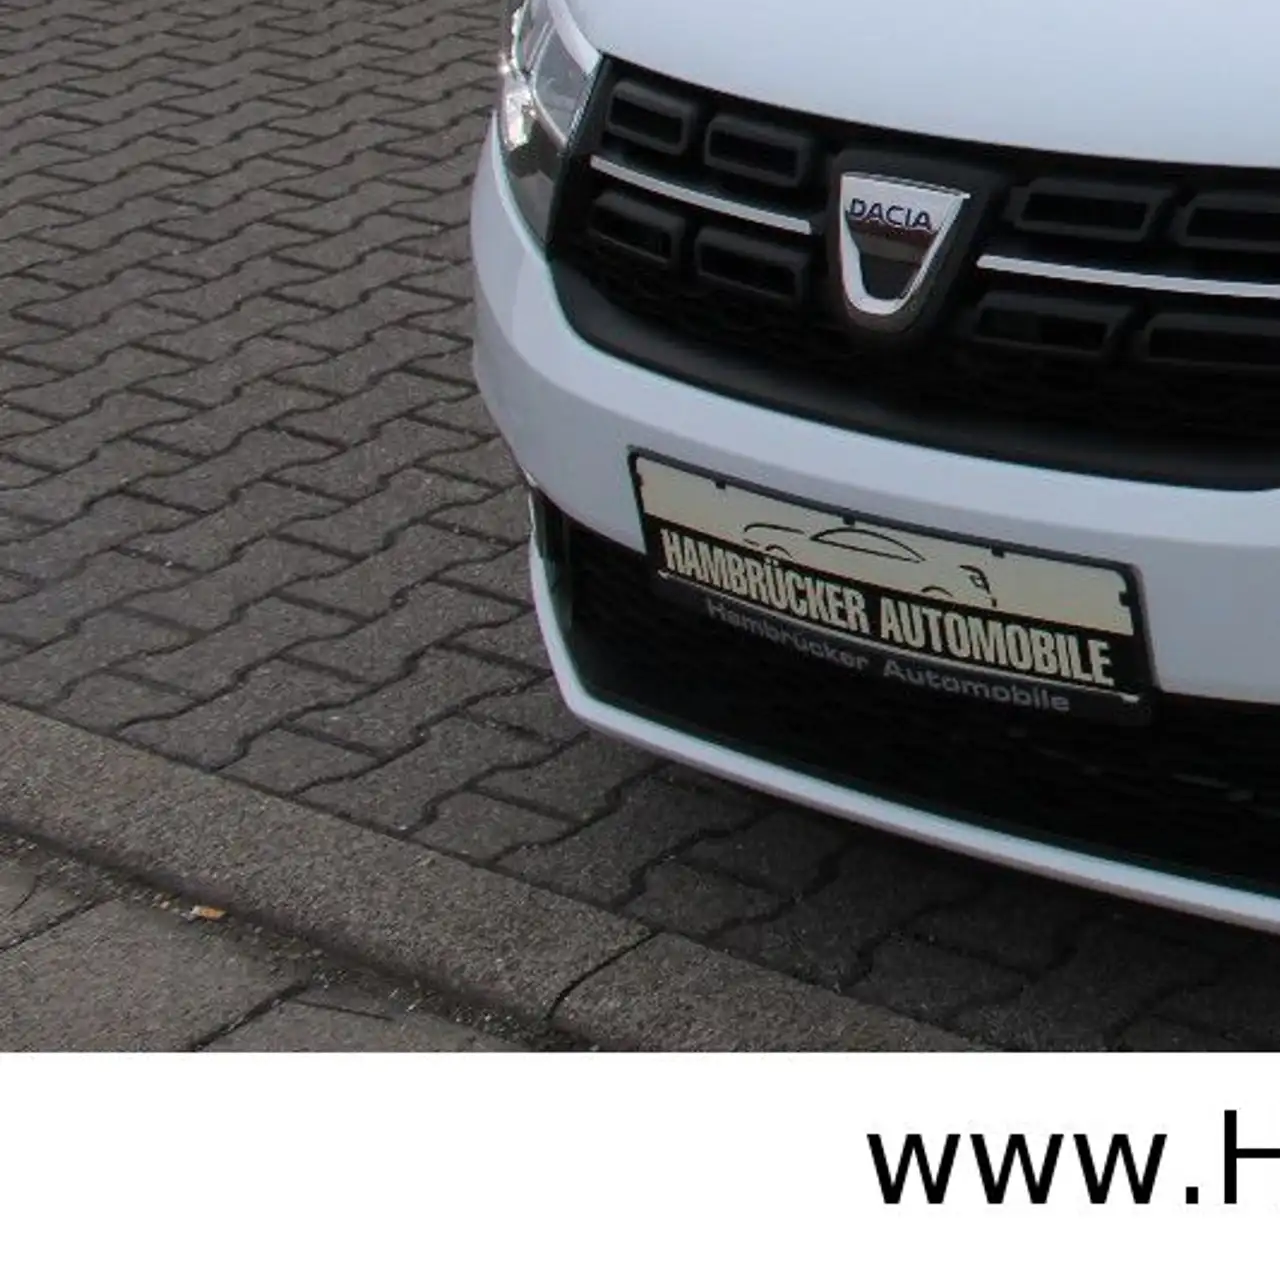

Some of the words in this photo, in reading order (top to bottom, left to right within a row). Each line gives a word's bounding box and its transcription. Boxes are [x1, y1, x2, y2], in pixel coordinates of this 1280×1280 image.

[850, 198, 931, 230] DACIA
[660, 528, 870, 634] HAMBRÜCKER
[880, 596, 1115, 687] AUTOMOBILE
[883, 658, 1070, 712] Automobile
